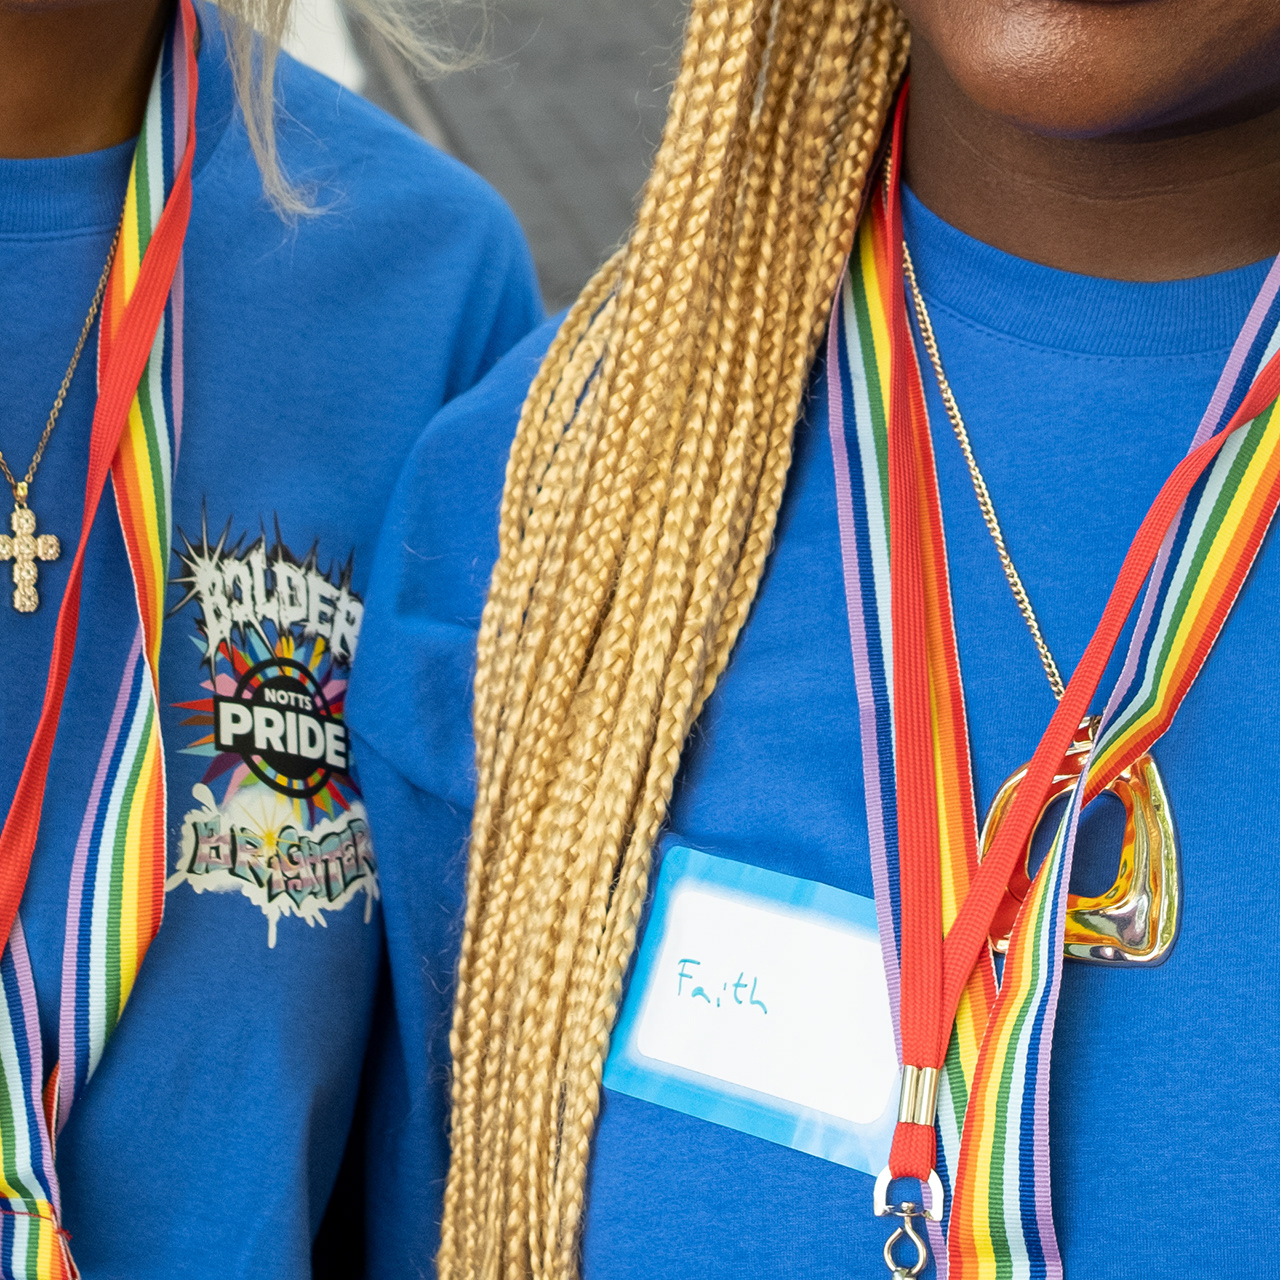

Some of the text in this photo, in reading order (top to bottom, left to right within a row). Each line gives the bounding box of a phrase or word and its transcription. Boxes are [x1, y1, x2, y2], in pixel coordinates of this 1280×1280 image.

[180, 520, 365, 680] BOLDER
[263, 686, 314, 712] NOTTS
[218, 700, 347, 770] PRIDE
[185, 817, 380, 908] BRIGHTER
[676, 958, 769, 1015] Faith
